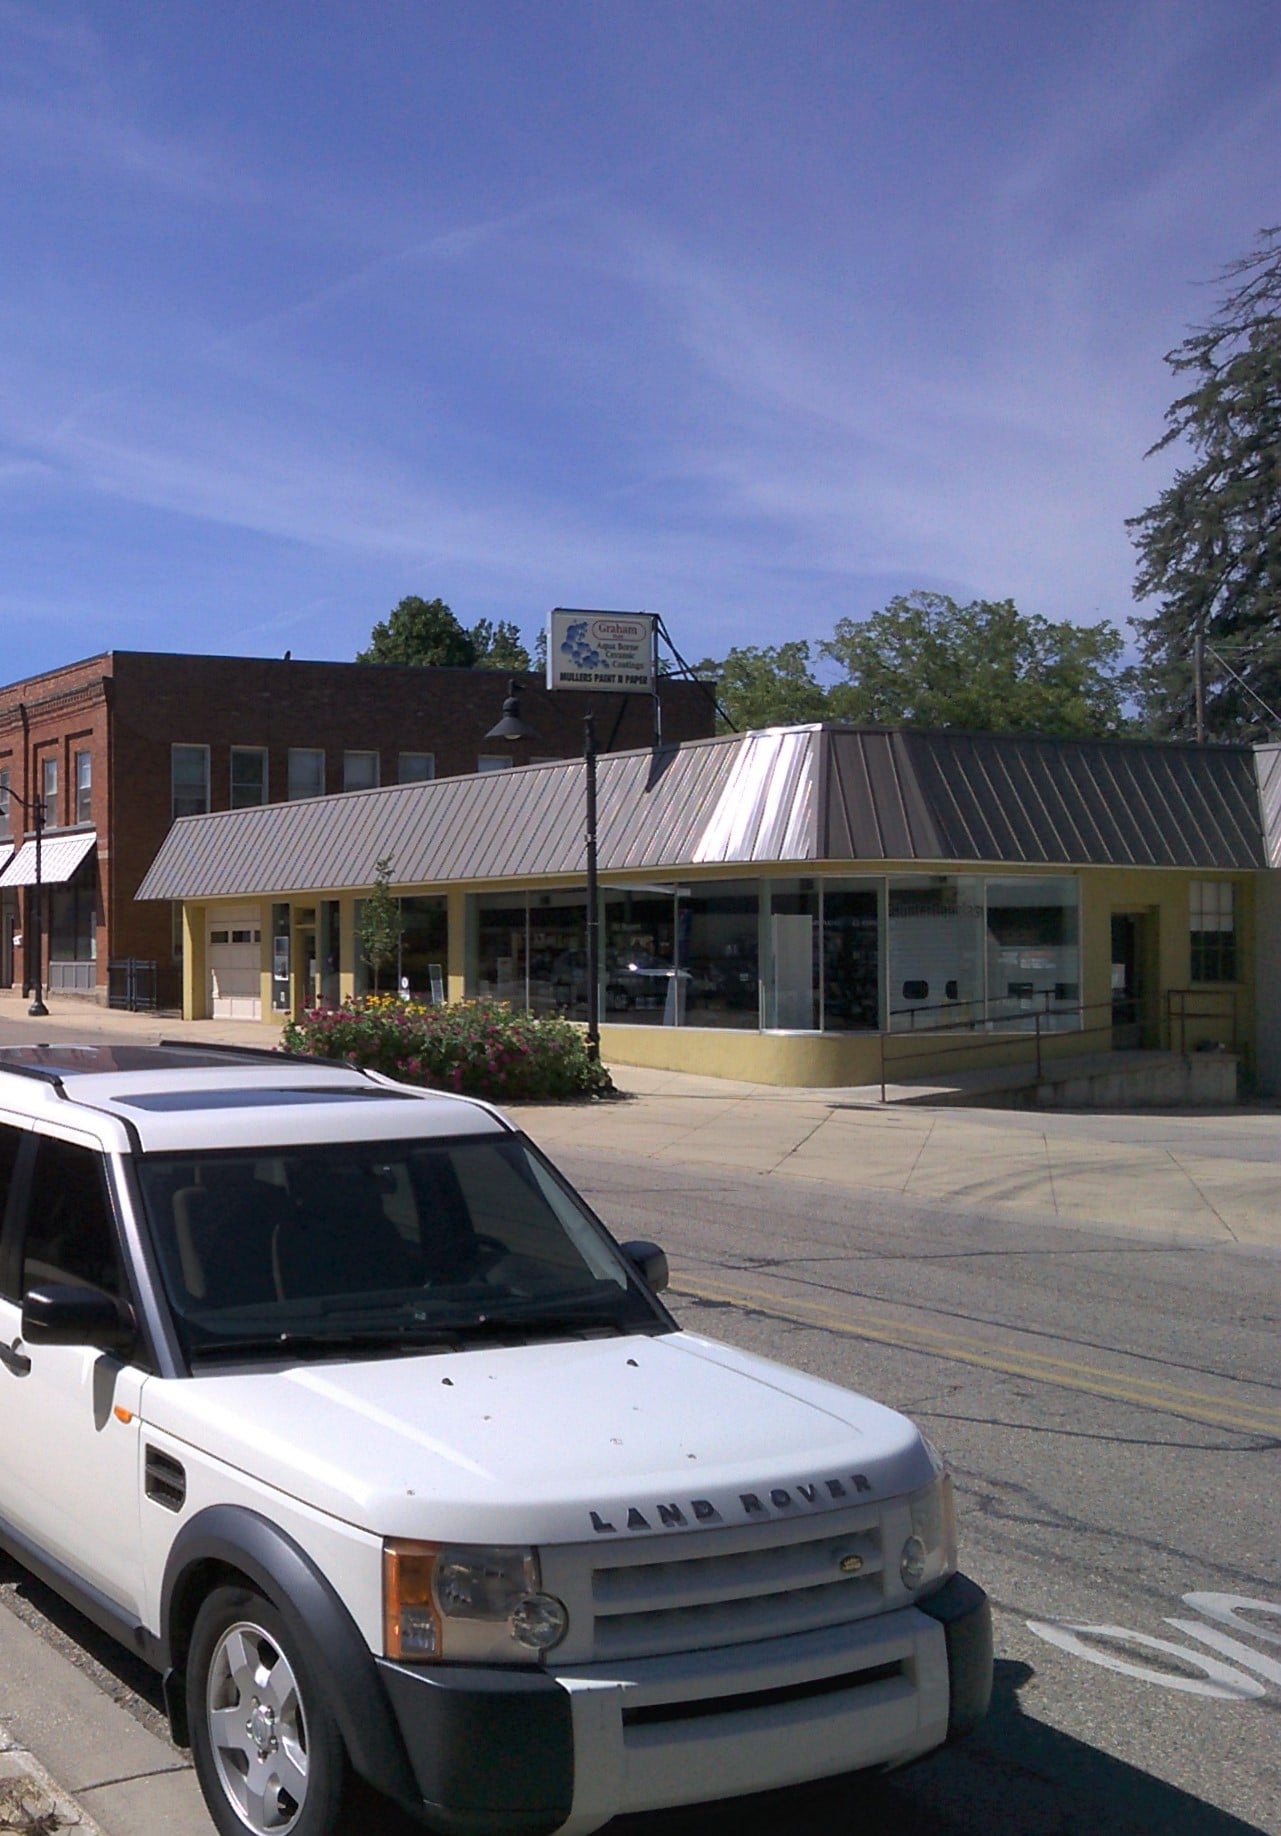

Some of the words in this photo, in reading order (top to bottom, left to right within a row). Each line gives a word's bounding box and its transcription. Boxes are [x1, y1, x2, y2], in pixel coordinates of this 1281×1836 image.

[598, 624, 638, 635] Graham
[594, 673, 616, 683] PAINT
[625, 675, 648, 685] PAPER
[589, 1499, 718, 1534] LAND
[738, 1473, 872, 1514] ROVER
